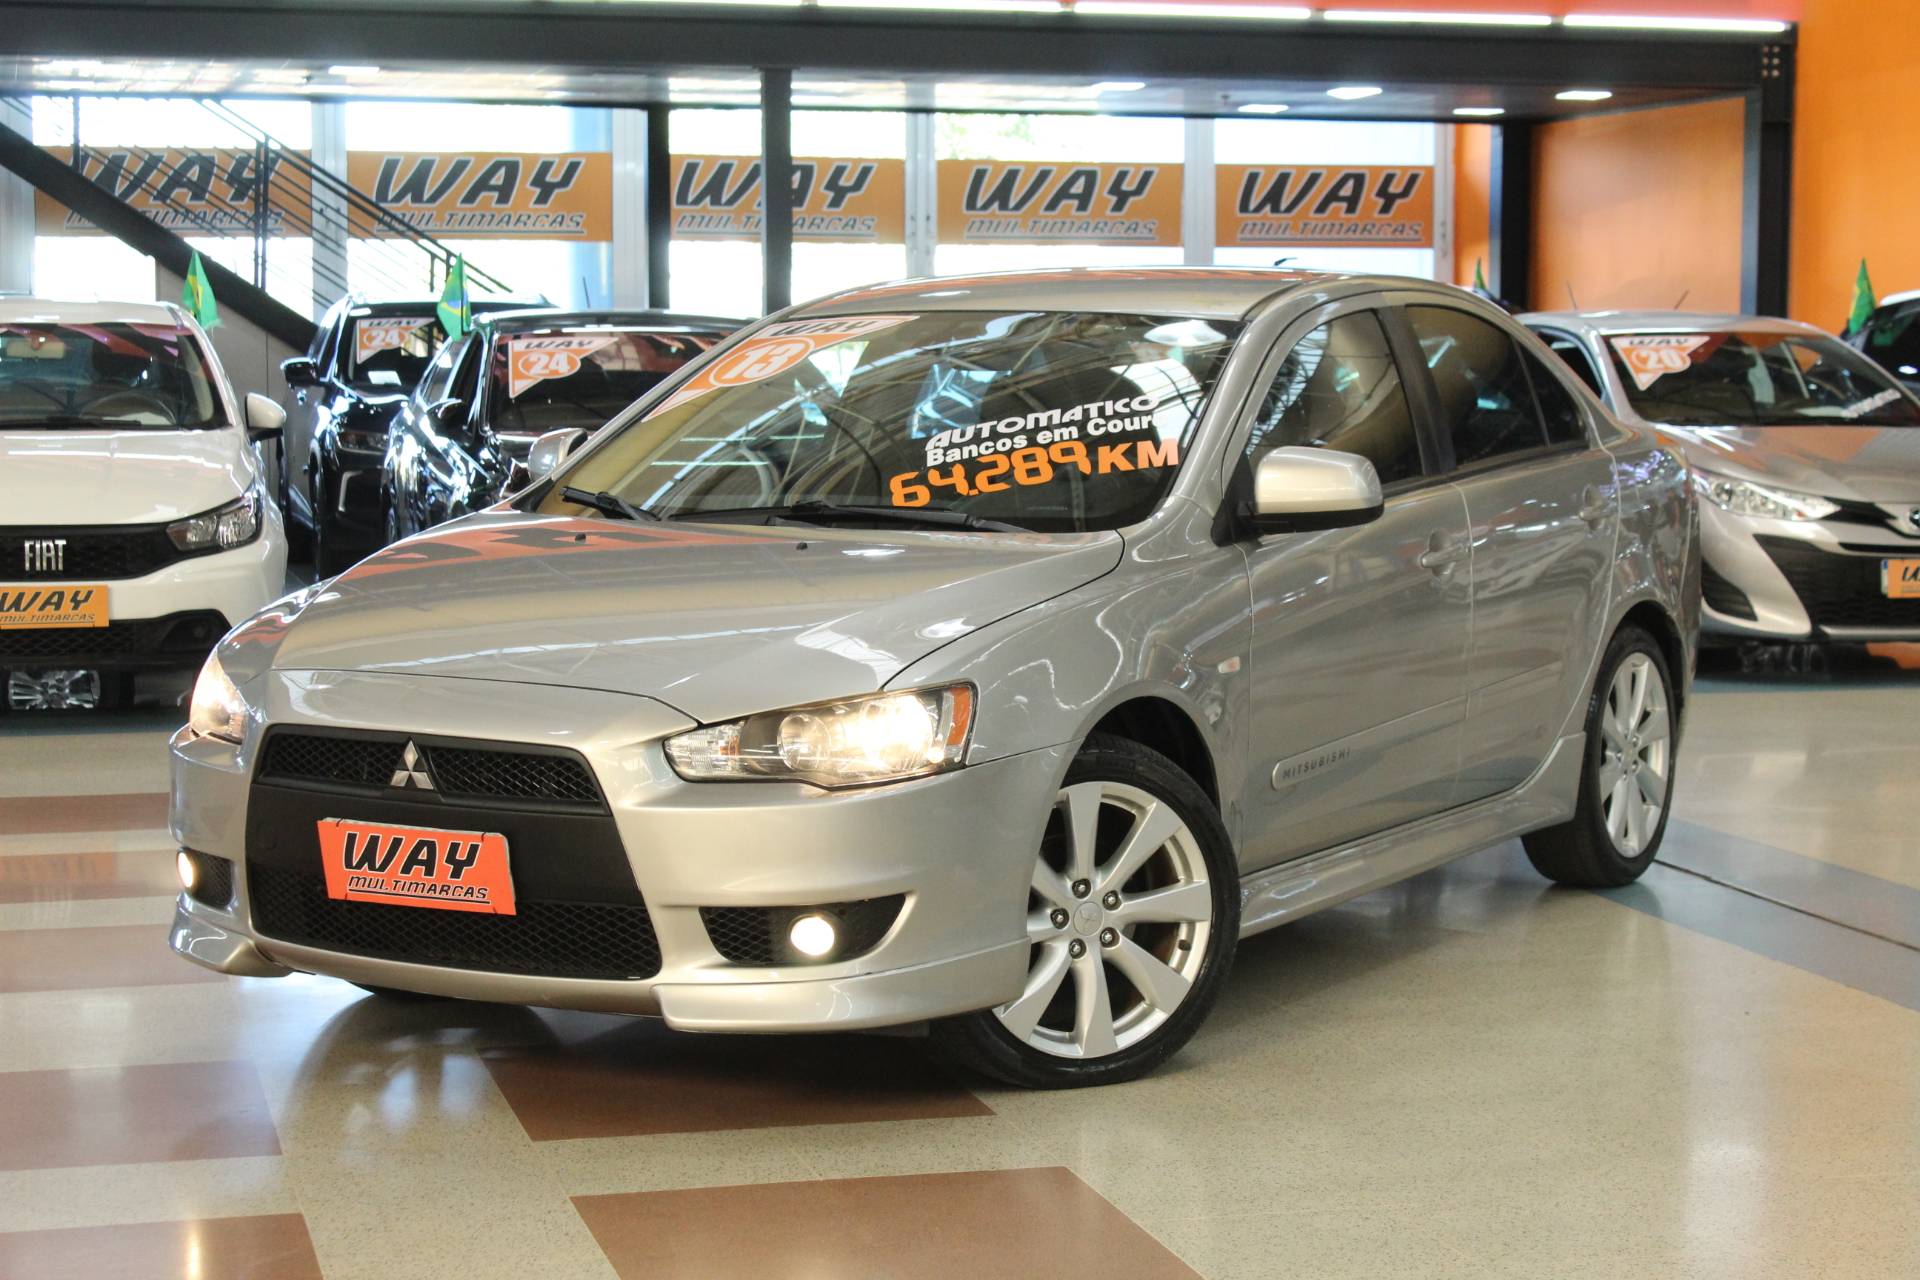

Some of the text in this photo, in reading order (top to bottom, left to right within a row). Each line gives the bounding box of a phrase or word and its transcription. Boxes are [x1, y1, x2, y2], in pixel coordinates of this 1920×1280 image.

[72, 152, 282, 204] WAY
[374, 157, 584, 208] WAY
[674, 160, 876, 211] WAY
[964, 166, 1157, 214] WAY
[1237, 170, 1423, 217] WAY
[377, 211, 585, 229] MULTIMARCAS
[677, 213, 876, 232] MULTIARCAS
[966, 219, 1157, 236] MULTIMARCAS
[1239, 222, 1423, 236] MULTIMARCAS
[368, 329, 403, 346] 24
[524, 340, 594, 349] WAY
[771, 320, 877, 338] WAY
[528, 352, 570, 375] 24
[720, 342, 805, 380] 13
[925, 394, 1160, 450] AUTOMATICO
[926, 433, 1028, 467] Bancos
[1036, 424, 1079, 446] em
[888, 437, 1180, 507] 64.289 KM
[24, 539, 67, 571] FIAT
[0, 590, 94, 612] WAY
[1282, 747, 1351, 779] MITSUBISHI
[344, 831, 482, 881] WAY
[349, 875, 489, 899] MULTIMARCAS
